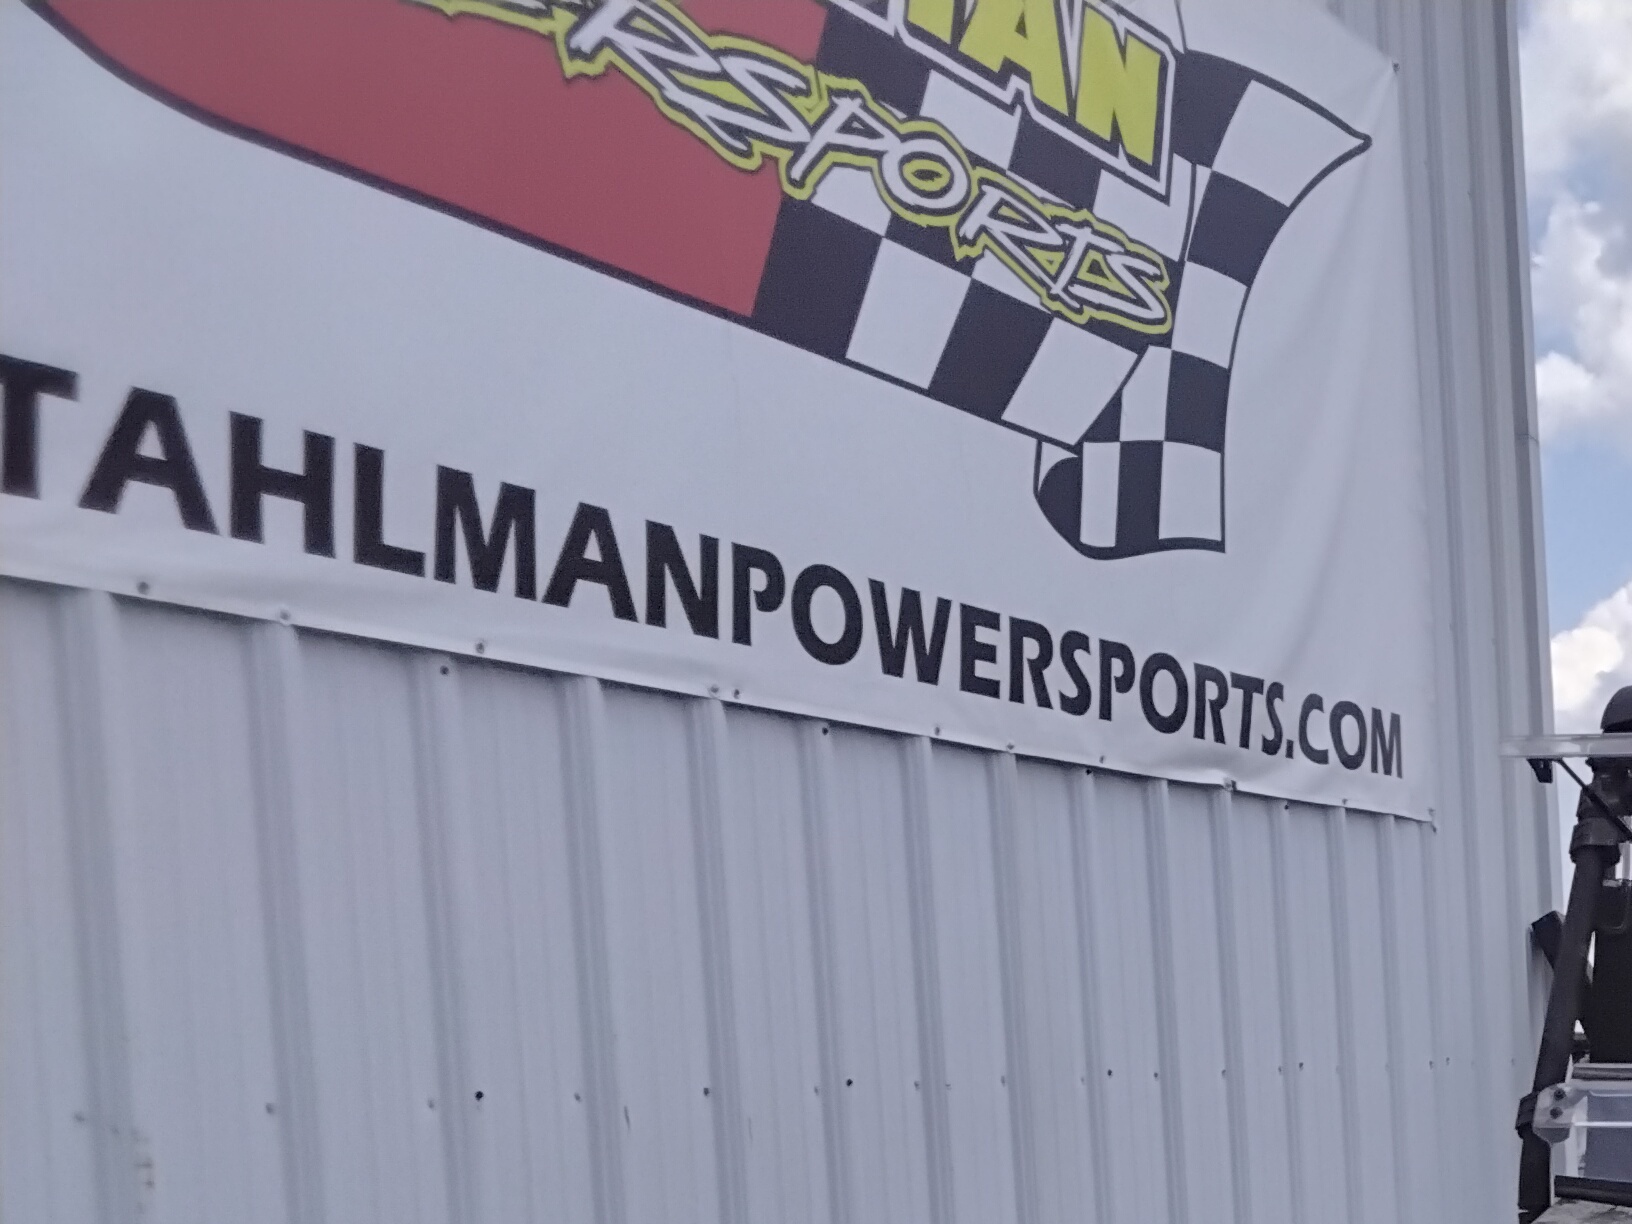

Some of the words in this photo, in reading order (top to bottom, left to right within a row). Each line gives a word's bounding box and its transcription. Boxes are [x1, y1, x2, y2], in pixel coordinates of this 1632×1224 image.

[508, 0, 1168, 325] RSPORTS
[906, 0, 1162, 167] AN
[0, 352, 1403, 779] TAHLMANPOWERSPORTS.COM
